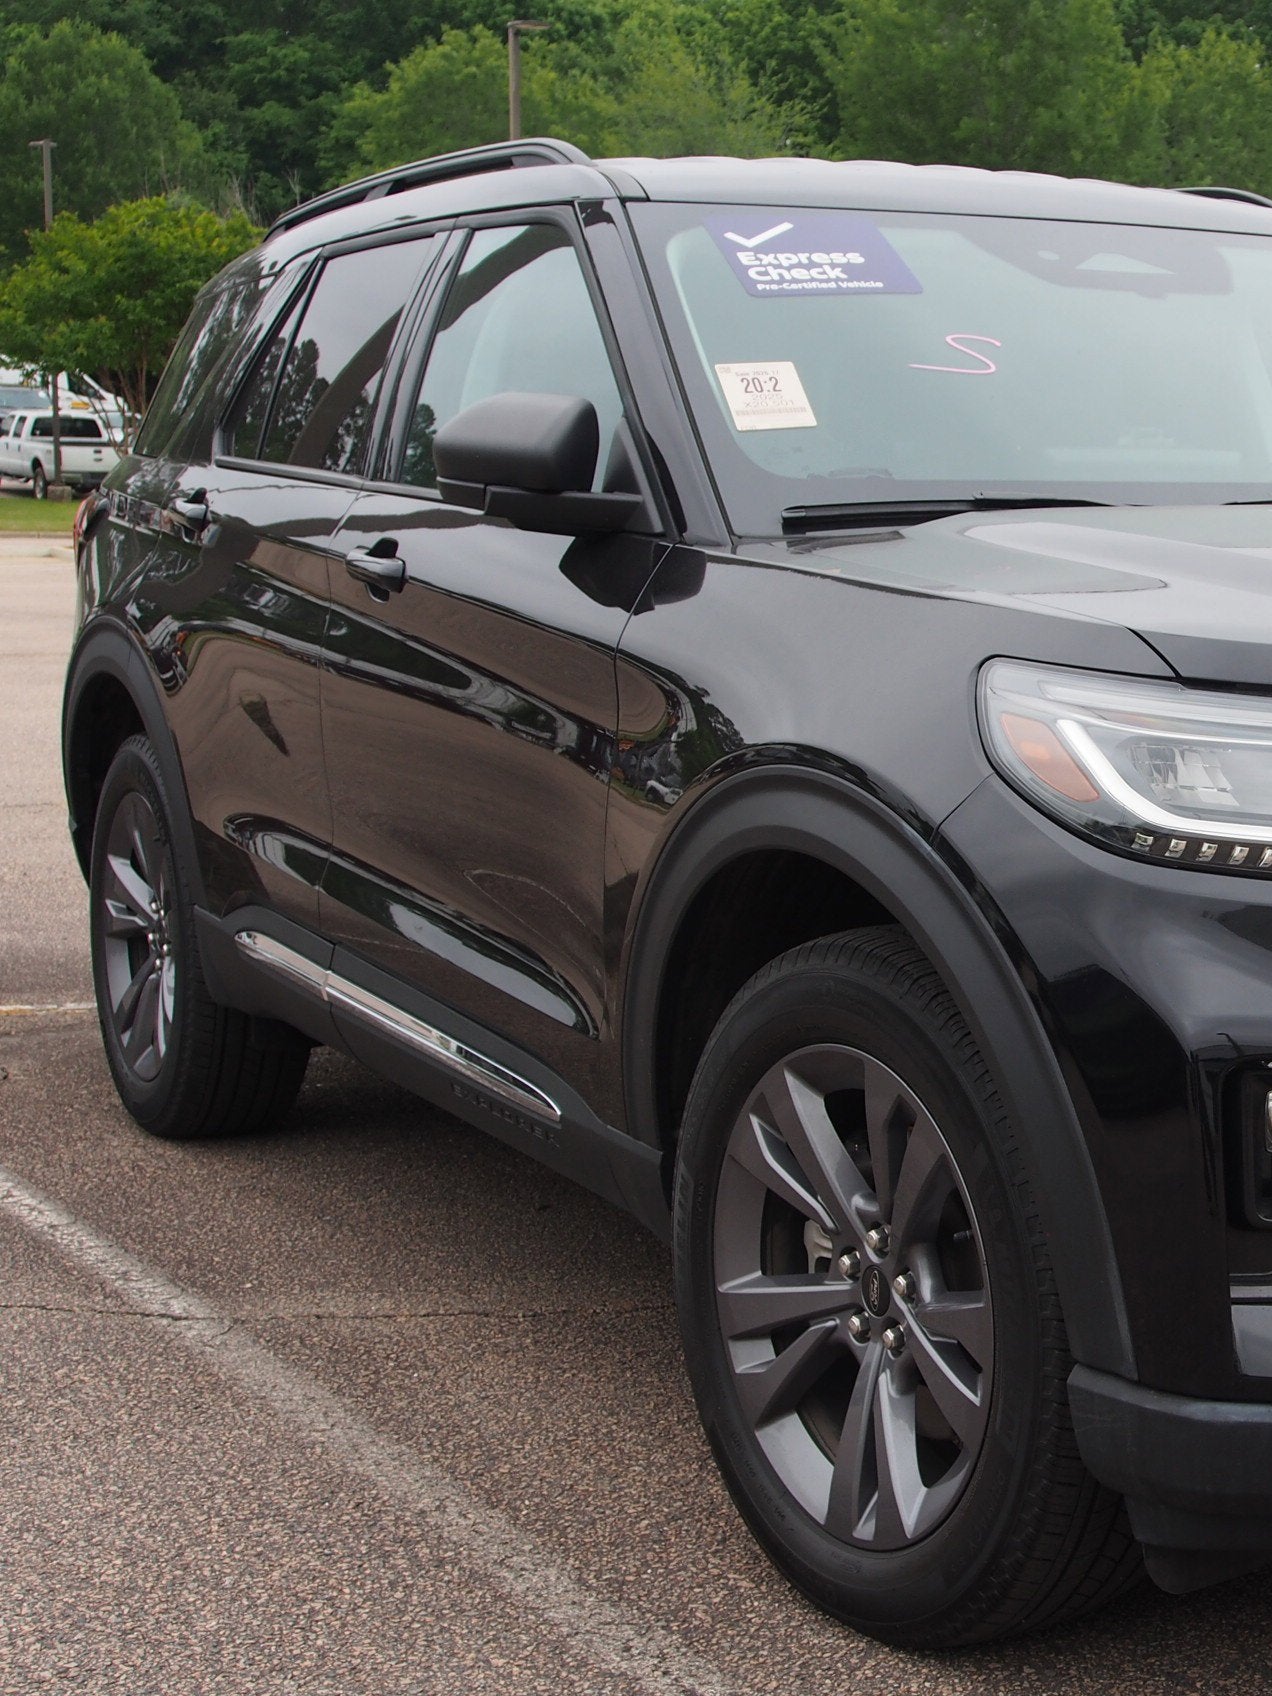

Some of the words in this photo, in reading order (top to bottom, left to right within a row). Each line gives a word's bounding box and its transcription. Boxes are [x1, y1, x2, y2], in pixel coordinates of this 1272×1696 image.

[736, 251, 866, 266] Express
[747, 265, 849, 281] Check
[756, 282, 837, 291] Pre-Certified
[740, 376, 782, 393] 20:2
